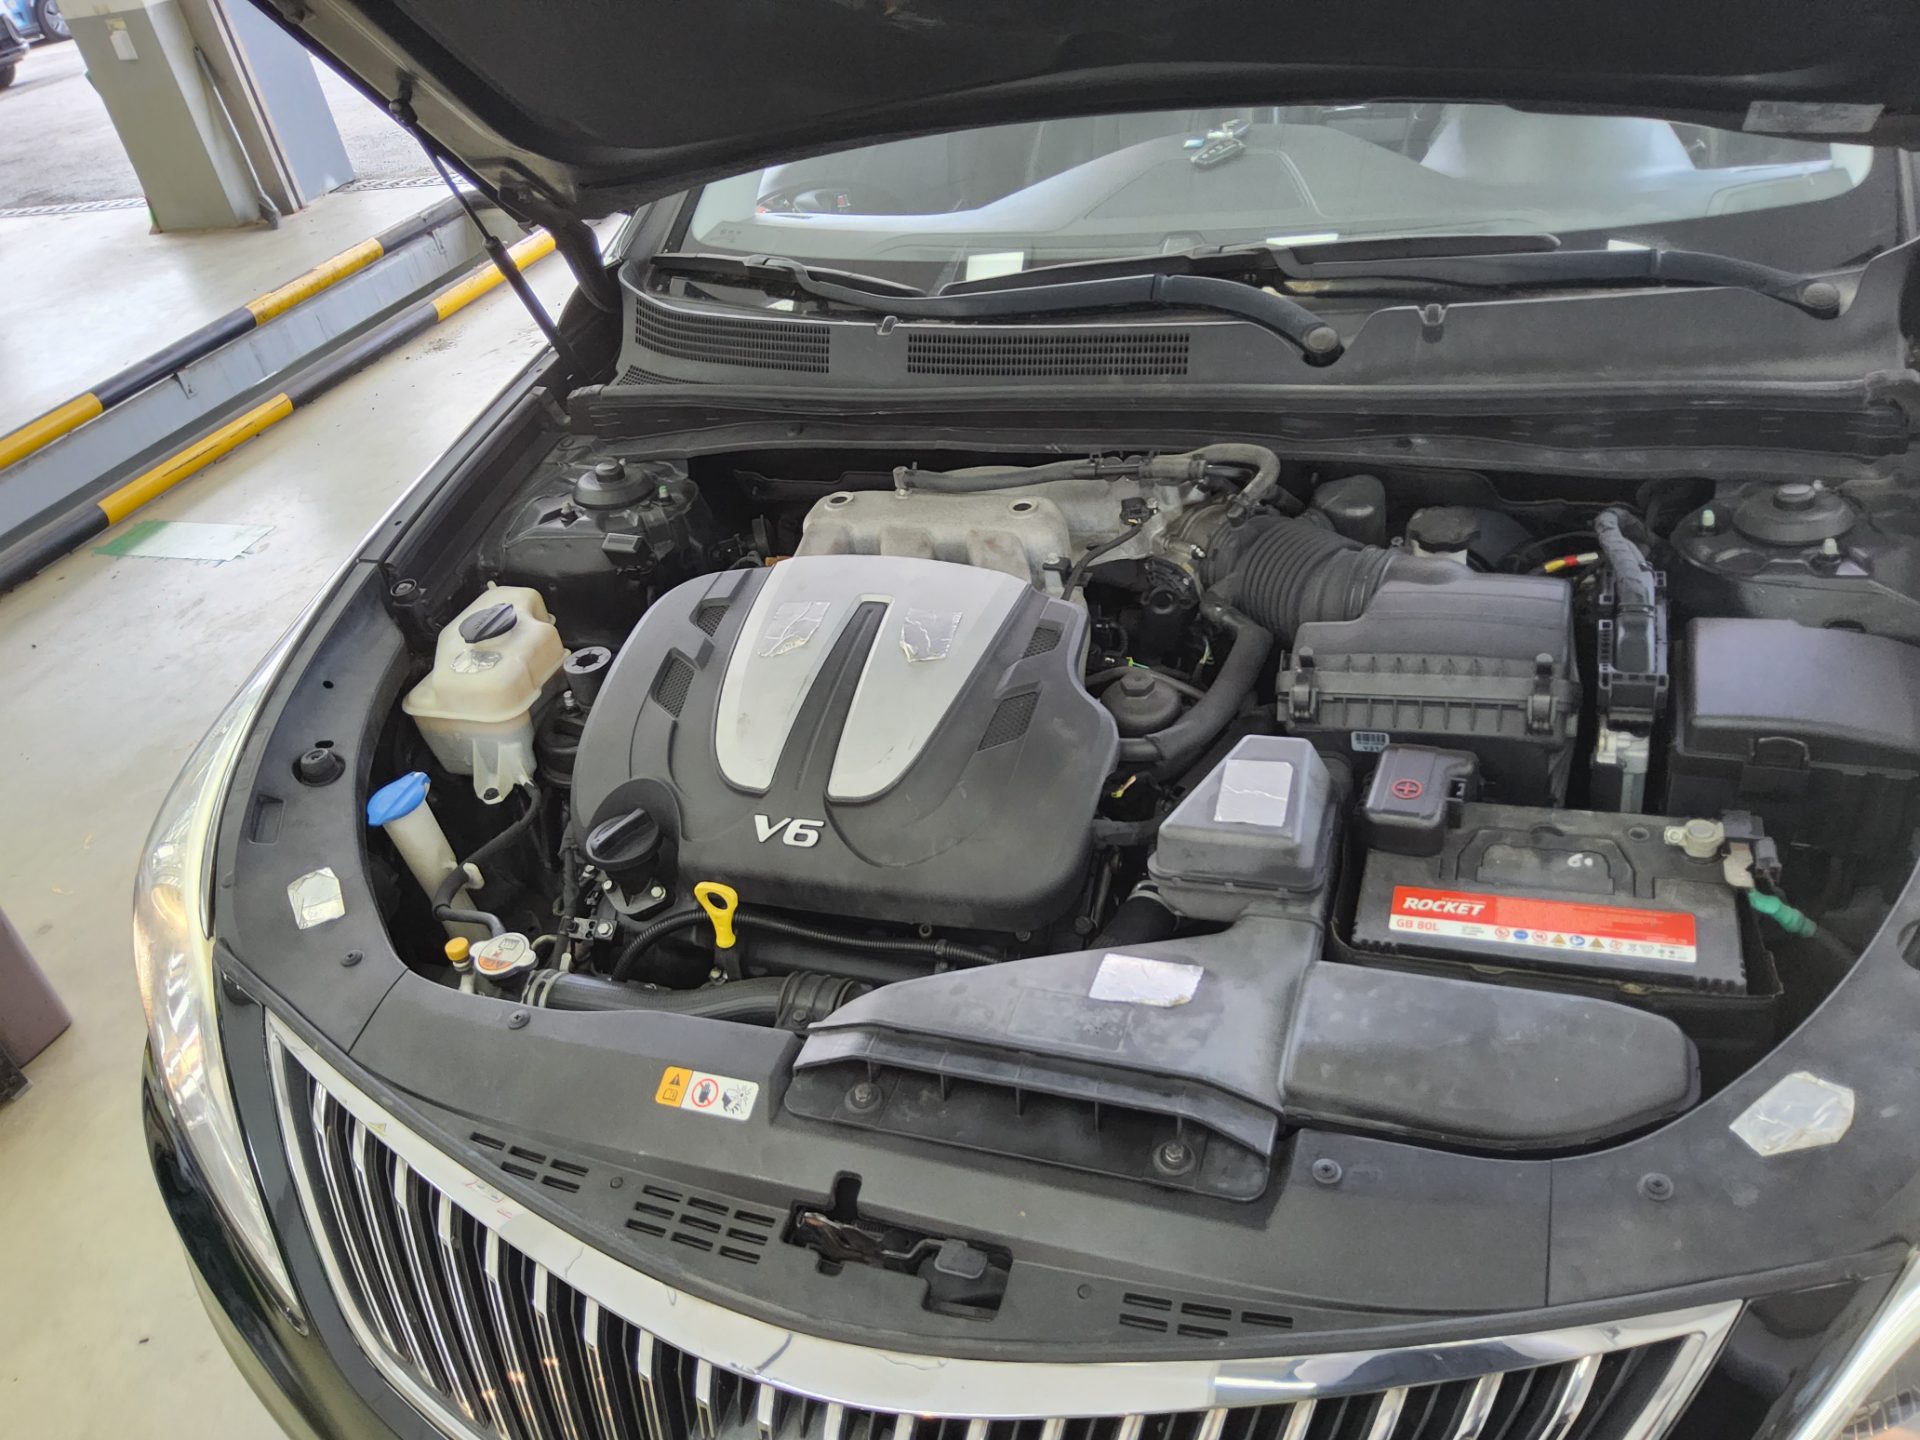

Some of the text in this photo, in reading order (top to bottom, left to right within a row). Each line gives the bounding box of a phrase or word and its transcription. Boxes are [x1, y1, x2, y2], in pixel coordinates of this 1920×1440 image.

[754, 814, 825, 848] V6
[1402, 896, 1486, 917] ROCKET
[1396, 918, 1441, 932] GB 80L
